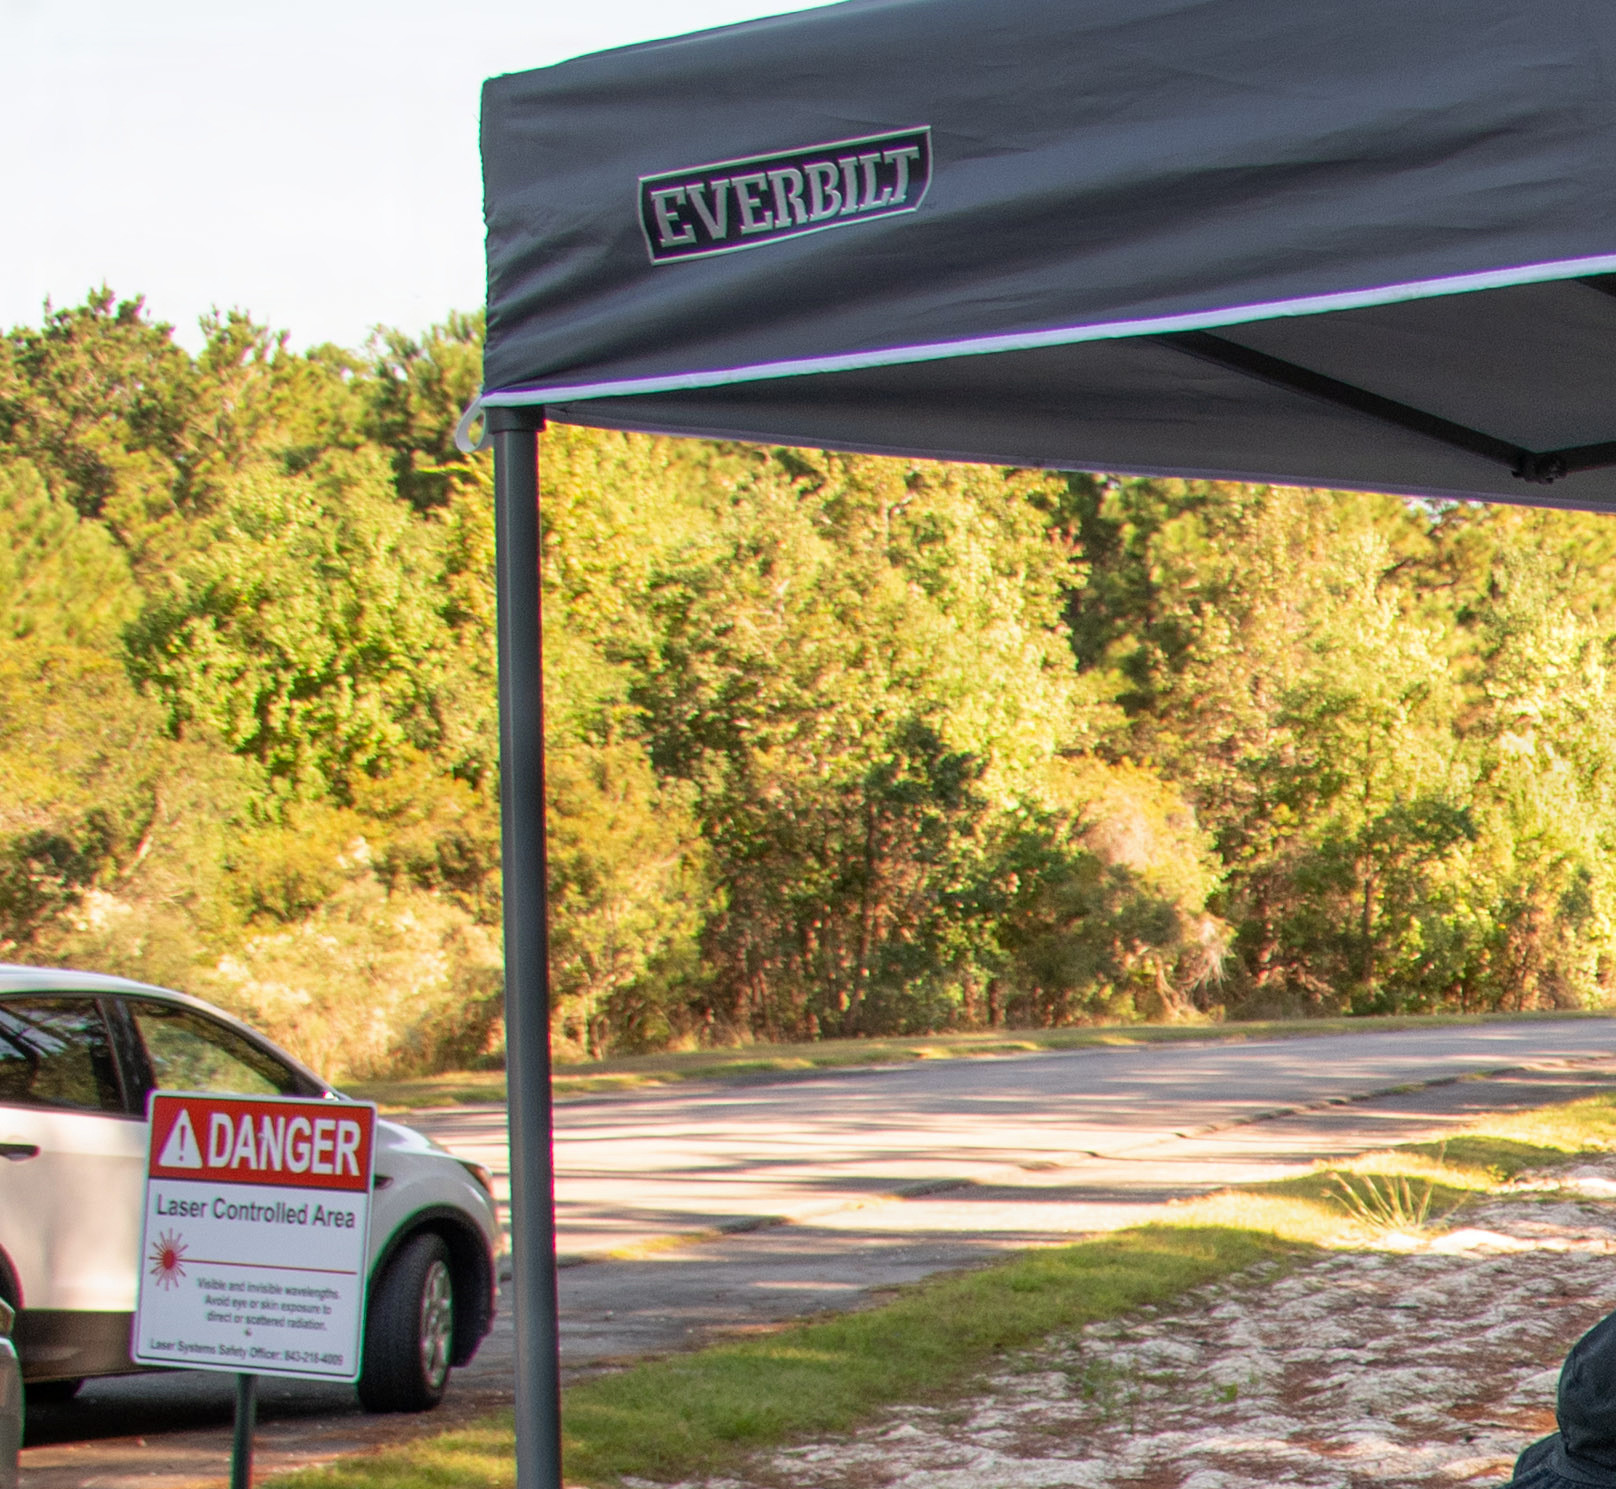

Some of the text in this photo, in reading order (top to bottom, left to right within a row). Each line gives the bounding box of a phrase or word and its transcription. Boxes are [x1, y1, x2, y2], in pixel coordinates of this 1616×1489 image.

[651, 146, 920, 248] EVERBILT
[207, 1112, 360, 1177] DANGER
[156, 1194, 356, 1229] Laser Controlled Area
[197, 1278, 227, 1290] Visible
[228, 1281, 245, 1292] and
[247, 1281, 283, 1295] invisible
[204, 1294, 332, 1315] Avoid eye or skin exposure to
[207, 1310, 232, 1322] direct
[234, 1315, 243, 1323] or
[245, 1314, 285, 1327] scattered
[150, 1337, 176, 1350] Laser
[177, 1340, 216, 1355] Systems
[219, 1343, 246, 1360] Safety
[250, 1346, 282, 1360] Officer:
